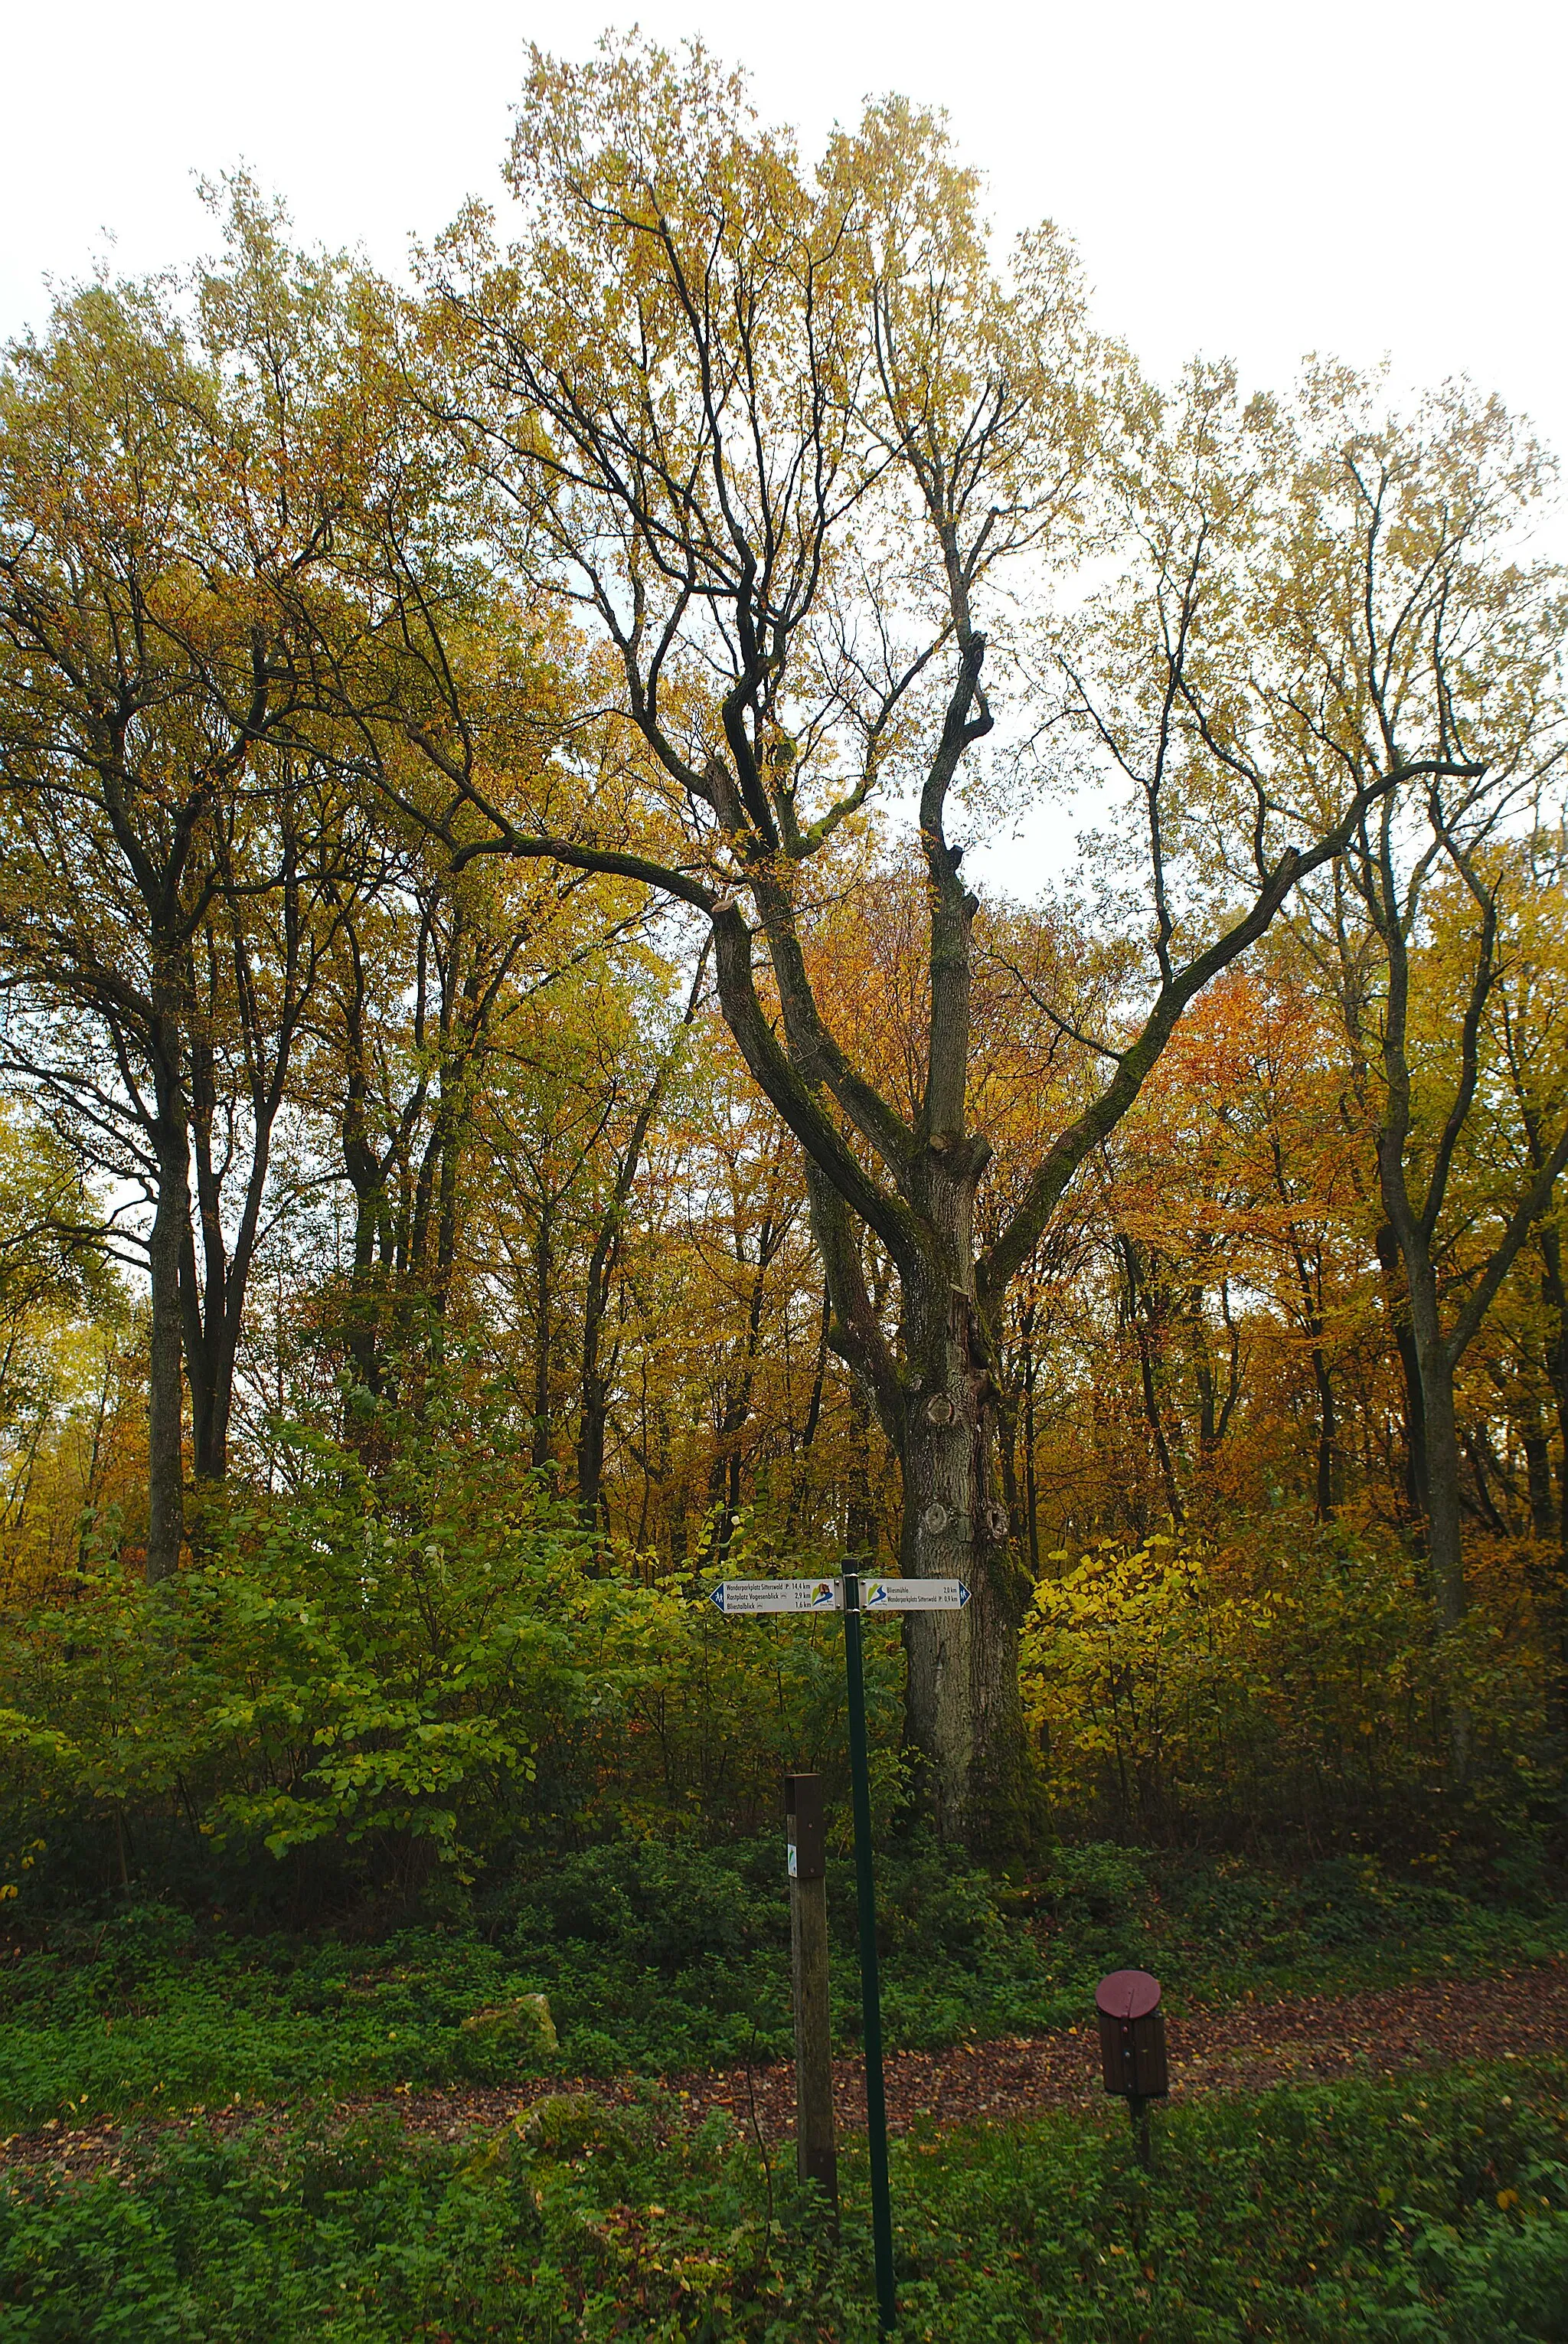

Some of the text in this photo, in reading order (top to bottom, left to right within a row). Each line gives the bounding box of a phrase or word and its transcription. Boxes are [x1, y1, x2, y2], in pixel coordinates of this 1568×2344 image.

[726, 1584, 760, 1592] Wanderparkplatz
[727, 1593, 748, 1601] Rastplatz
[749, 1592, 779, 1601] Vogesenblick
